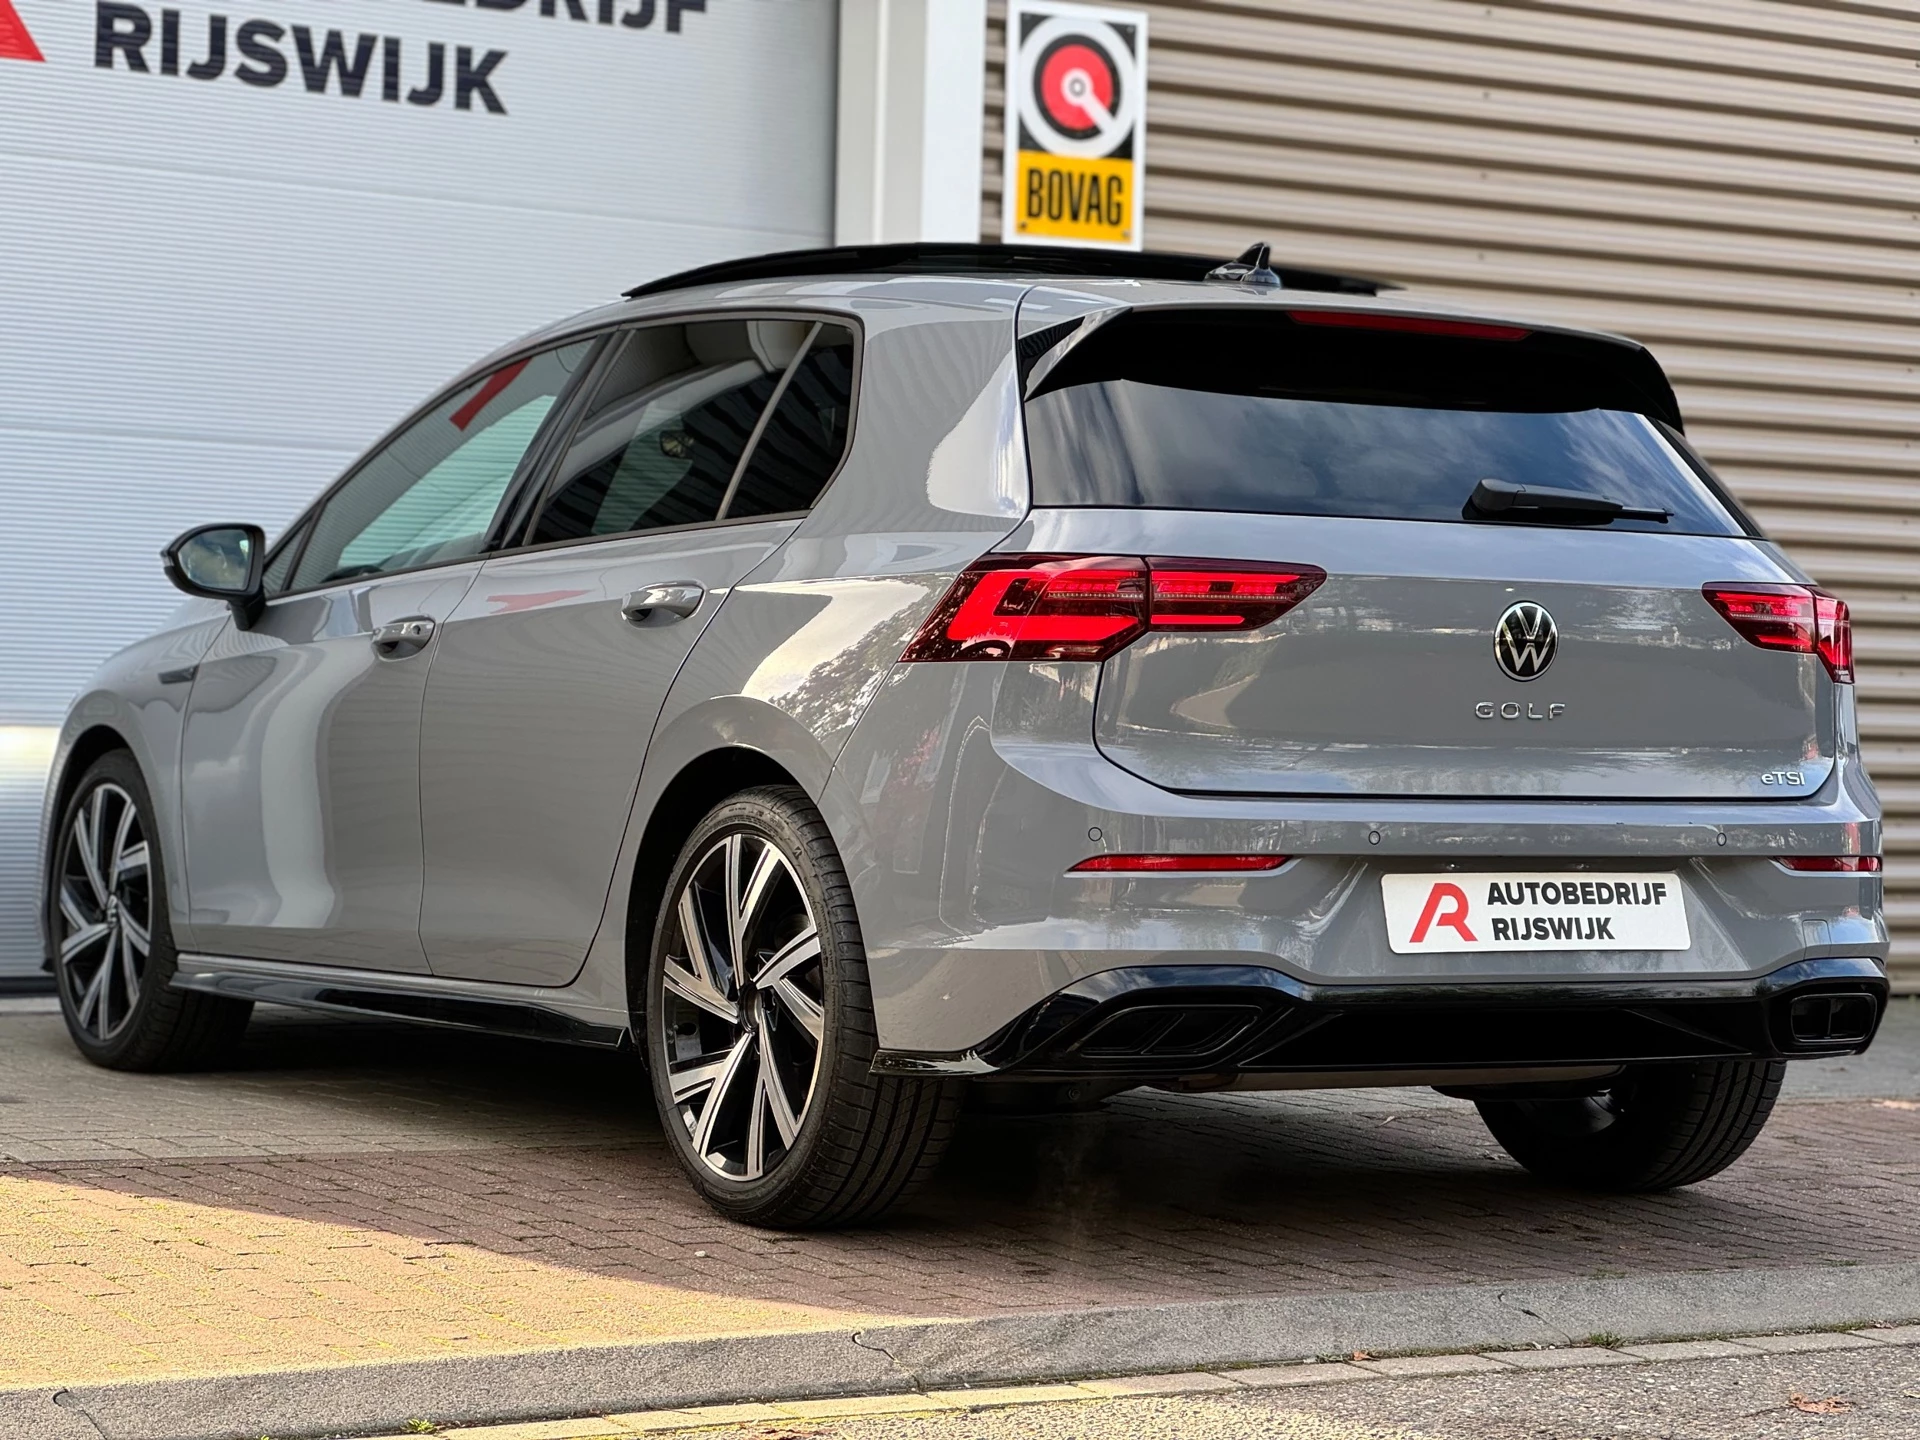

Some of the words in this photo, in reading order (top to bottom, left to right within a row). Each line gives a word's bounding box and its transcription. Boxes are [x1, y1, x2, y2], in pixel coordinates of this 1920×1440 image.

[94, 1, 507, 115] RIJSWIJK
[1027, 168, 1123, 227] BOVAG
[1475, 701, 1566, 720] GOLF
[1761, 771, 1806, 786] eTSI
[1487, 881, 1668, 906] AUTOBEDRIJF
[1491, 917, 1616, 941] RIJSWIJK
